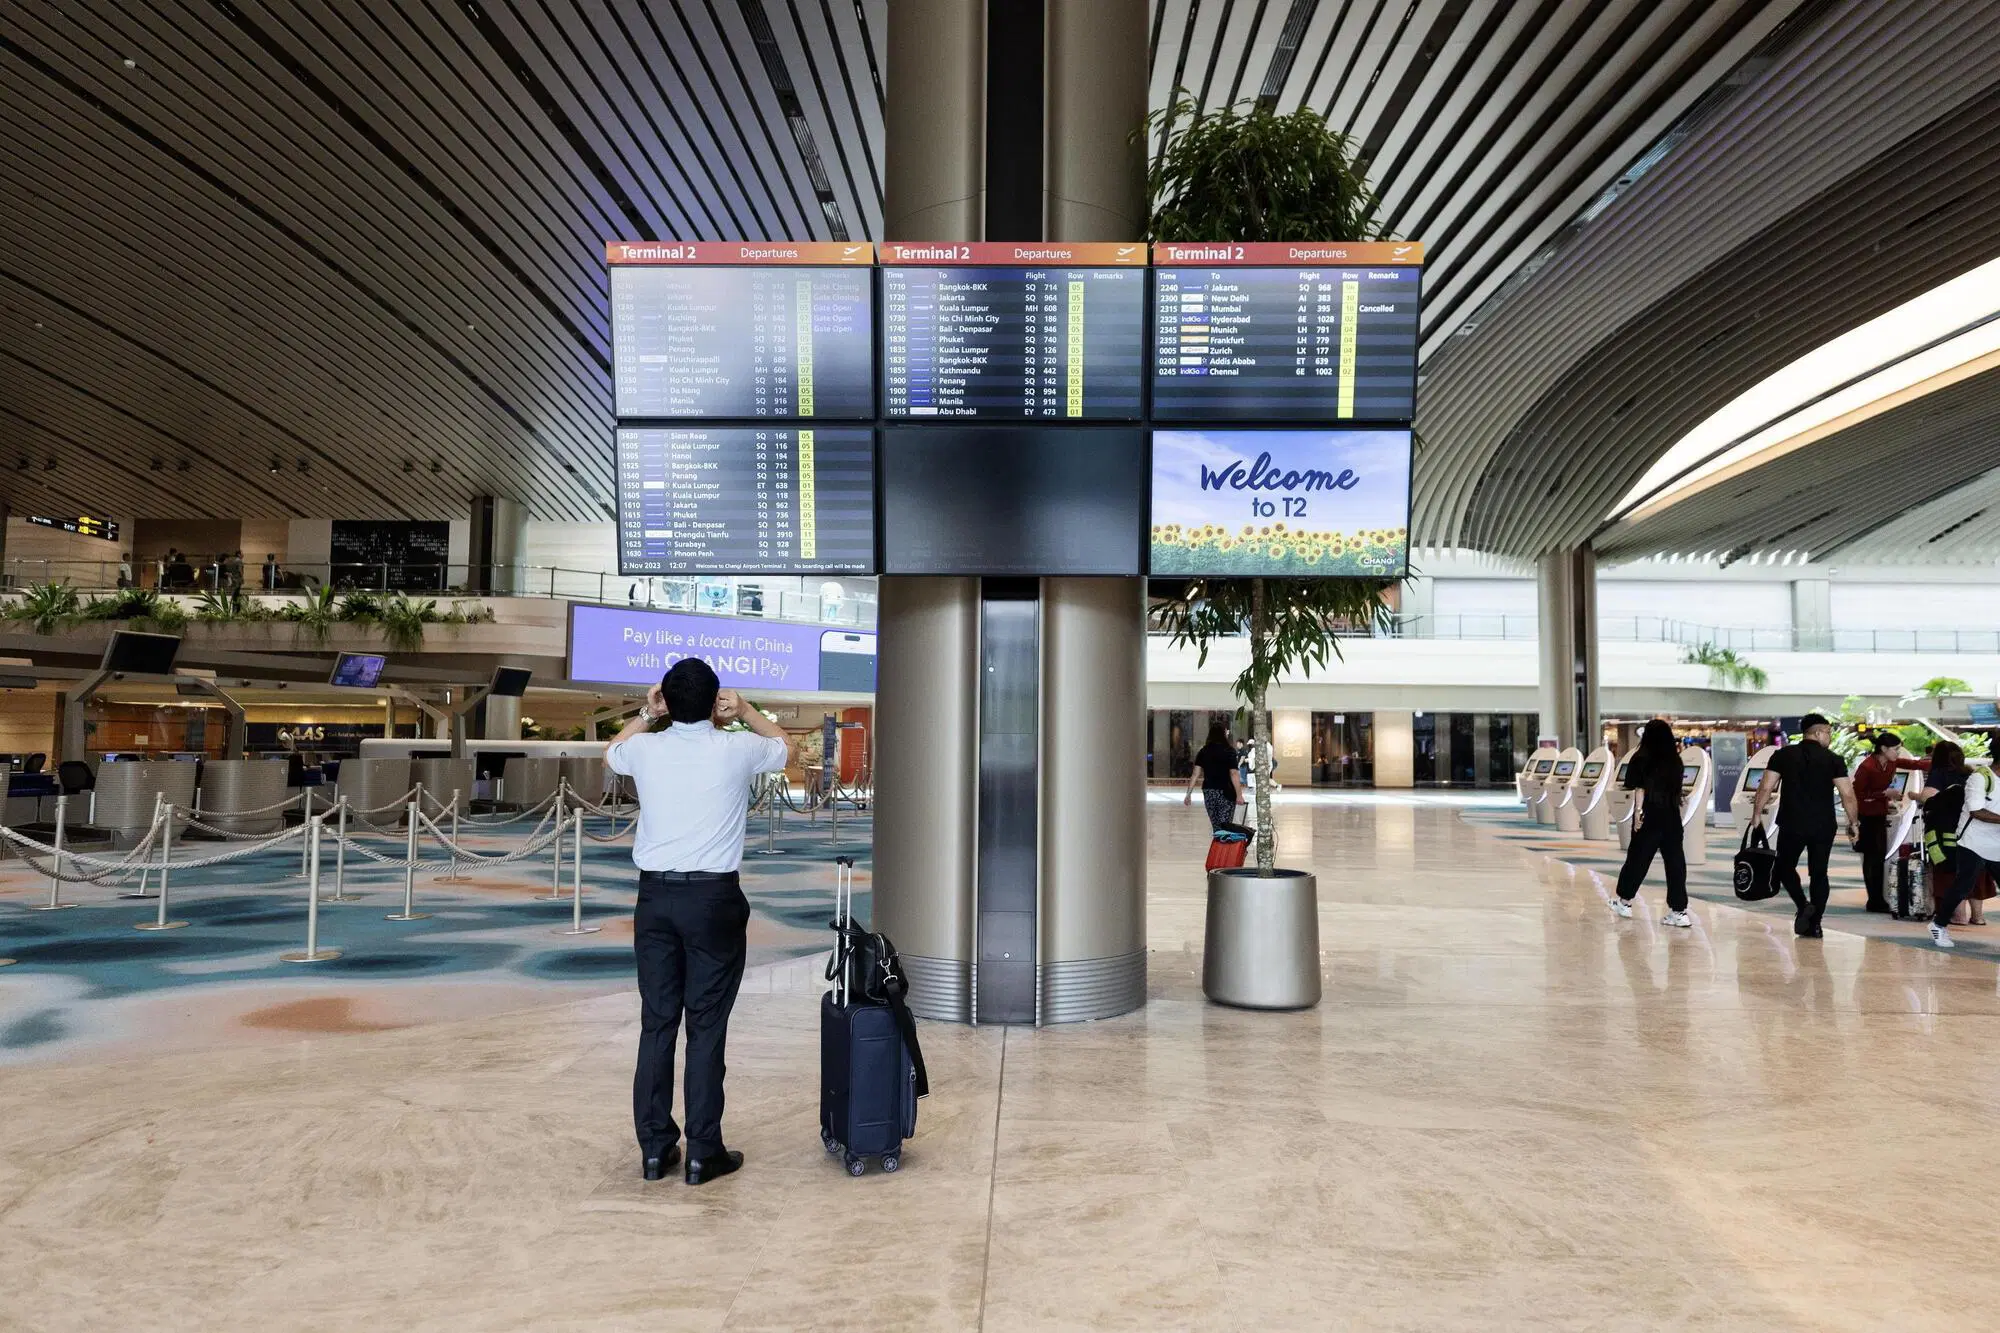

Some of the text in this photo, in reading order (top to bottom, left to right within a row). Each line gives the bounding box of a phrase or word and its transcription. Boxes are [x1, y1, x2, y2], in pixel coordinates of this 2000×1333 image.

[620, 245, 696, 259] Terminal 2
[740, 248, 798, 260] Departures
[893, 246, 970, 259] Terminal 2
[1014, 249, 1072, 260] Departures
[1167, 247, 1244, 260] Terminal 2
[1289, 248, 1347, 260] Departures
[886, 271, 1124, 281] Time To Flight Row Remarks
[1159, 272, 1399, 281] Time To Flight Row Remarks
[939, 283, 1058, 293] Bangkok-BKK SQ 714
[1160, 283, 1332, 293] 2240 Jakarta SQ 968
[939, 293, 966, 301] Jakarta
[1160, 294, 1178, 303] 2300
[1211, 294, 1228, 302] New
[1230, 294, 1249, 302] Delhi
[1317, 294, 1331, 302] 383
[939, 304, 1058, 314] Kuala Lumpur MH 608
[1160, 305, 1178, 313] 2315
[1211, 305, 1241, 313] Mumbai
[1317, 305, 1331, 313] 395
[1359, 304, 1394, 312] Cancelled
[939, 314, 1000, 324] Ho Chi Minh City
[1159, 315, 1178, 324] 2325
[1210, 315, 1251, 325] Hyderabad
[1297, 315, 1307, 323] 6E
[1317, 315, 1335, 323] 1028
[939, 325, 993, 335] Bali Denpasar
[1159, 326, 1330, 334] 2345 Munich LH 791
[939, 335, 965, 343] Phuket
[1159, 336, 1330, 344] 2355 Frankfurt LH 779
[939, 346, 989, 355] Kuala Lumpur
[1159, 347, 1329, 355] 0005 Zurich LX 177
[939, 356, 988, 366] Bangkok-BKK
[1159, 357, 1329, 365] 0200 Addis Ababa ET 639
[939, 366, 981, 374] Kathmandu
[1158, 368, 1177, 376] 0245
[1209, 367, 1239, 376] Chennai
[1295, 368, 1305, 376] 6E
[1315, 368, 1333, 376] 1002
[889, 377, 1057, 387] 1900 Penang SQ 142
[755, 387, 766, 395] SQ
[939, 387, 1057, 396] Medan SQ 994
[889, 397, 1057, 407] 1910 Manila SQ 918
[756, 408, 767, 416] SQ
[889, 407, 907, 415] 1915
[939, 407, 954, 415] Abu
[955, 407, 977, 415] Dhabi
[1024, 408, 1034, 416] EY
[1042, 408, 1056, 416] 473
[756, 432, 767, 441] SQ
[1200, 451, 1360, 491] Welcome
[693, 482, 720, 491] Lumpur
[672, 501, 698, 509] Jakarta
[1252, 497, 1307, 517] to T2
[673, 511, 697, 519] Phuket
[692, 521, 725, 530] Denpasar
[674, 531, 705, 540] Chengdu
[674, 540, 706, 549] Surabaya
[724, 563, 742, 571] Changi
[742, 563, 761, 571] Airport
[802, 563, 824, 571] boarding
[623, 627, 793, 653] Pay like a local in China
[626, 652, 790, 681] with CANGI Pay
